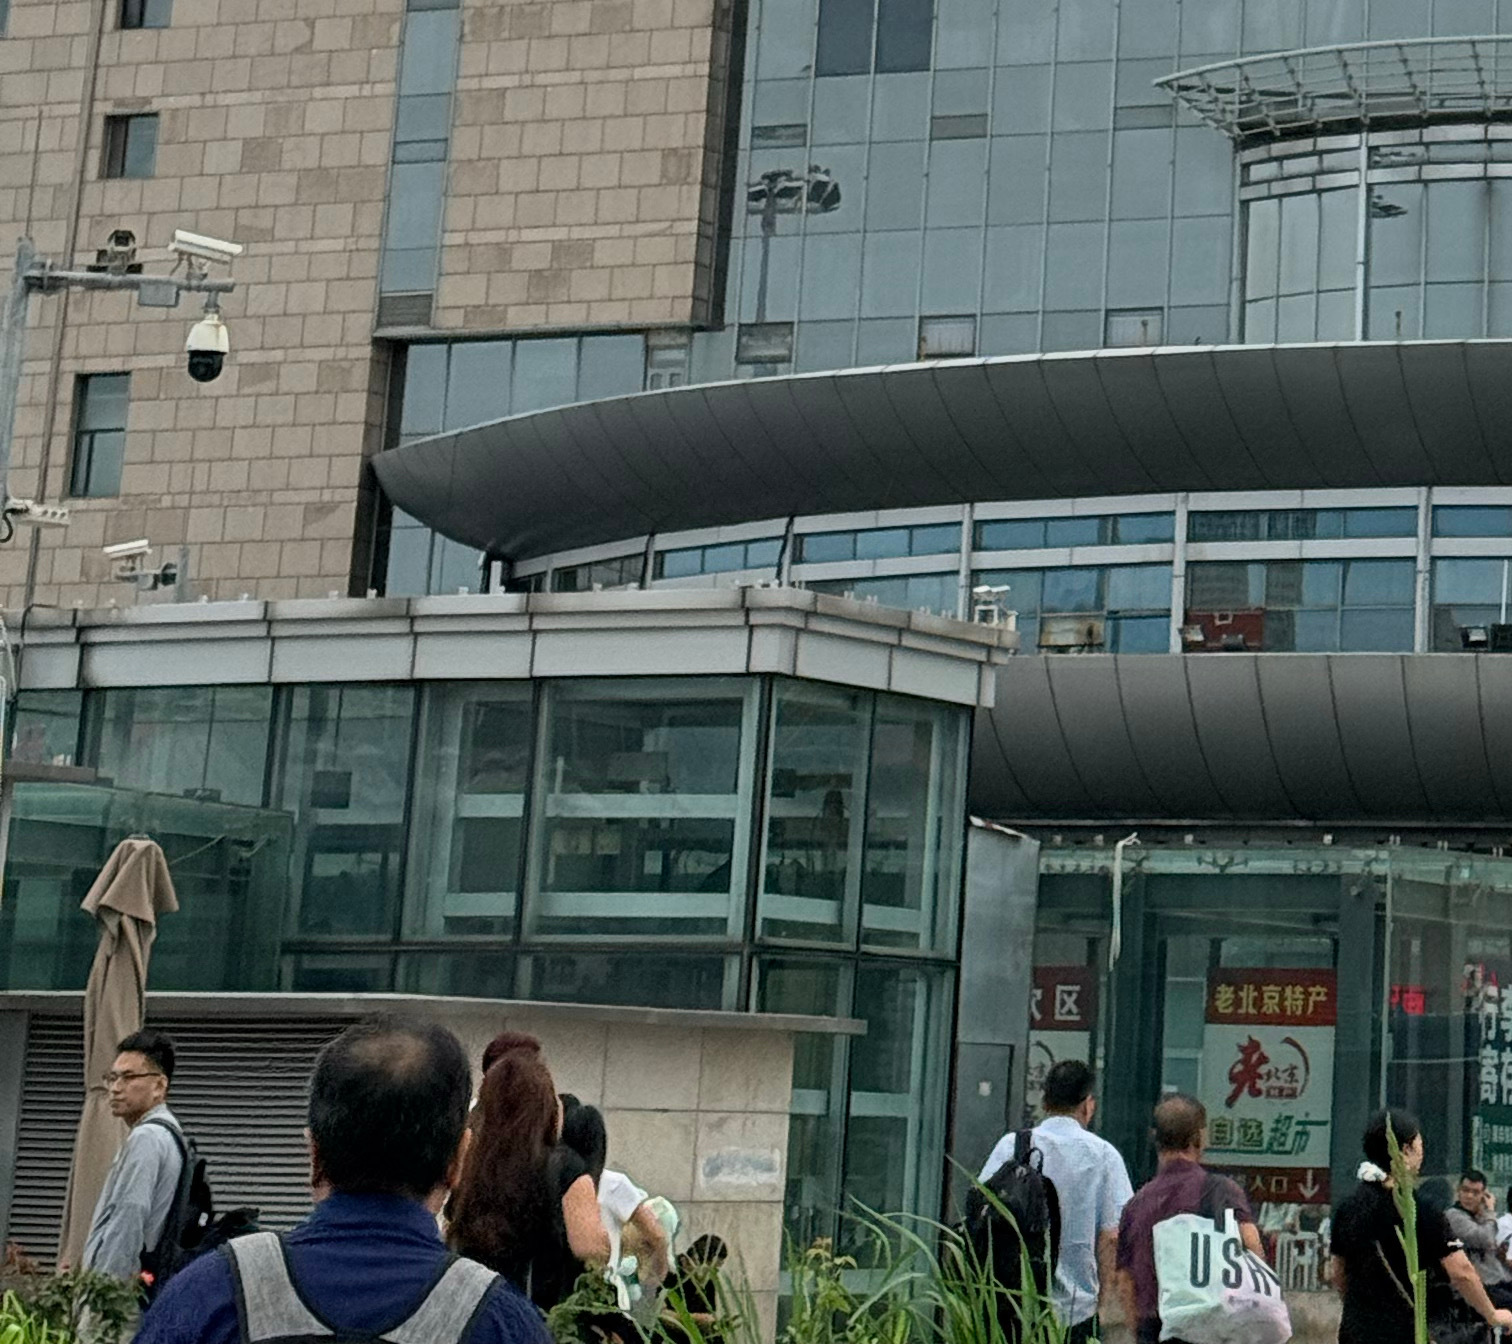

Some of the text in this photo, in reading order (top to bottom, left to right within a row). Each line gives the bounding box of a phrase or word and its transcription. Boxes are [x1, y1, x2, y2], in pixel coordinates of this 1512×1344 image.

[1214, 985, 1328, 1015] 老北京特产
